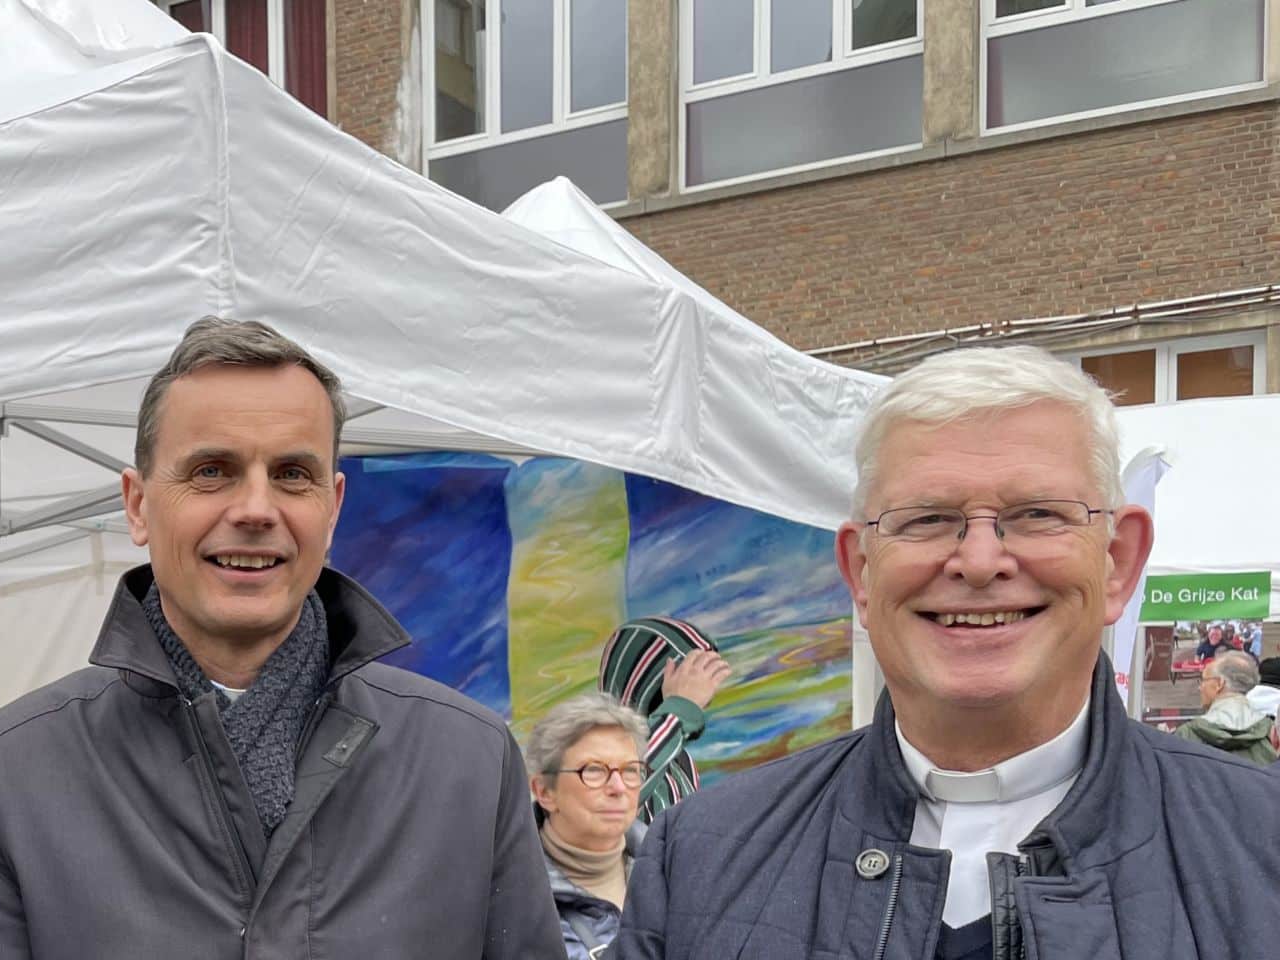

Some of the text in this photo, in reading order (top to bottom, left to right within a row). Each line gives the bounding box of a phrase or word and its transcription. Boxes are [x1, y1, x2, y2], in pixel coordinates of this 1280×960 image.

[1151, 590, 1173, 604] De
[1178, 588, 1225, 605] Grijze
[1231, 587, 1259, 601] Kat
